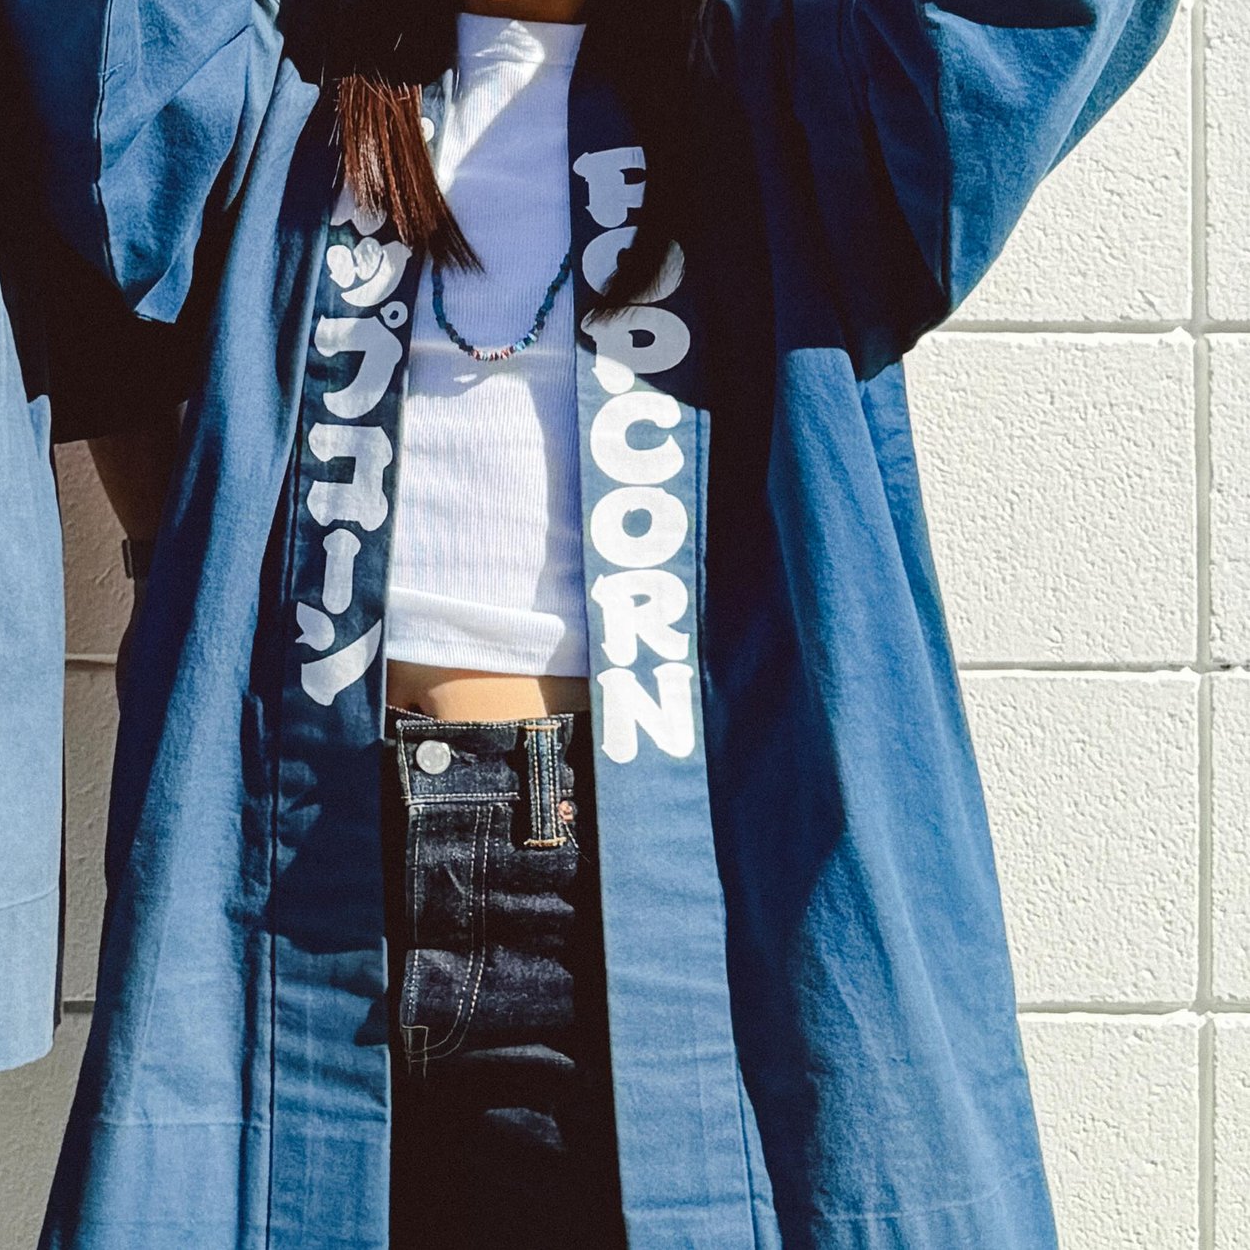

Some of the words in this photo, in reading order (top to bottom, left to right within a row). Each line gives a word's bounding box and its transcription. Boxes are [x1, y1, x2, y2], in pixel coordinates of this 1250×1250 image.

[296, 178, 413, 706] ップコーン
